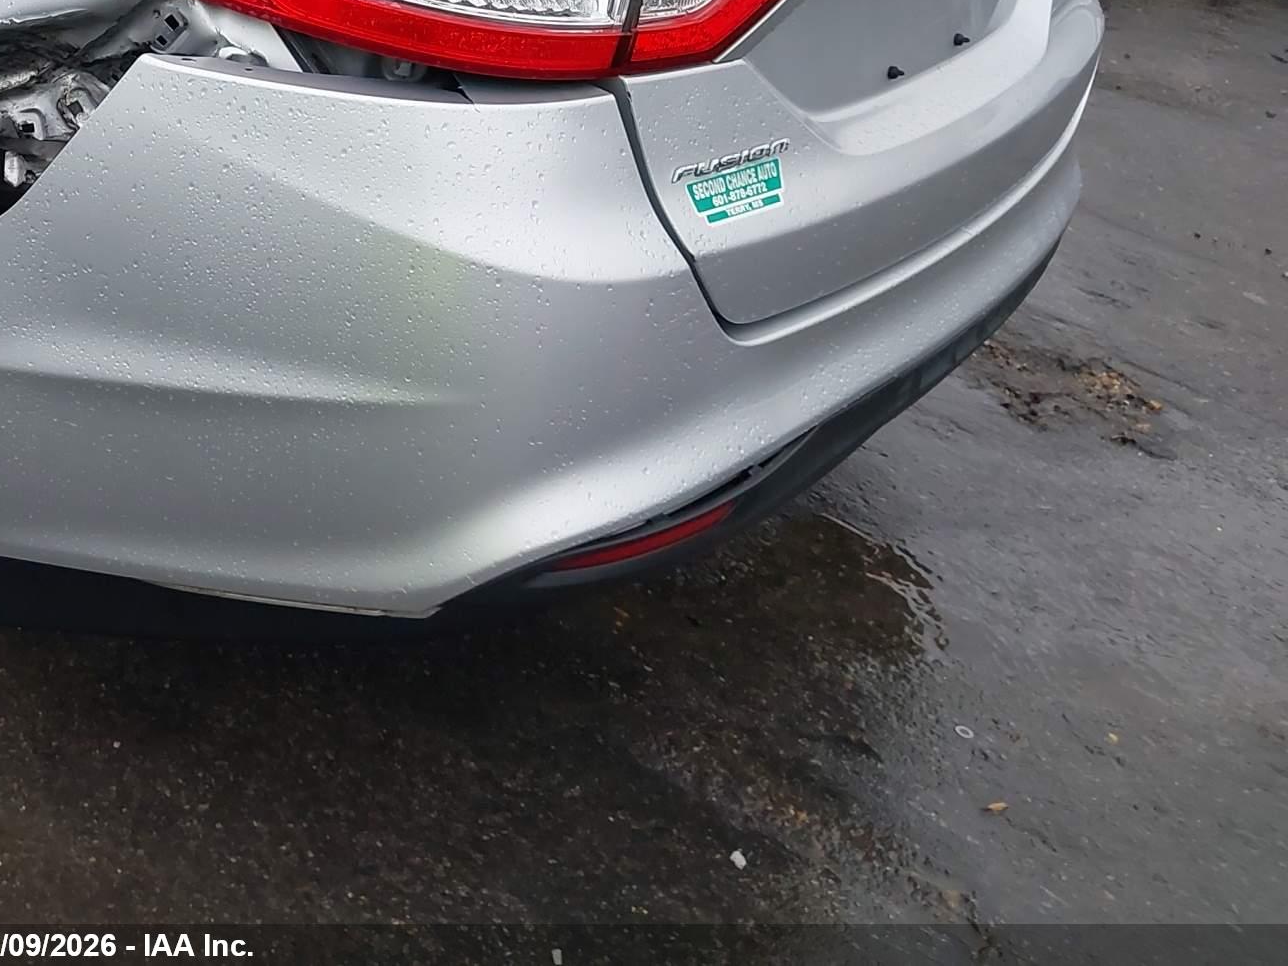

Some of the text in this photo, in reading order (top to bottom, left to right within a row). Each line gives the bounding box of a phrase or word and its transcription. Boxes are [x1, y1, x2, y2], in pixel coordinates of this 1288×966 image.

[692, 162, 778, 201] SECOND CHANCE AUTO
